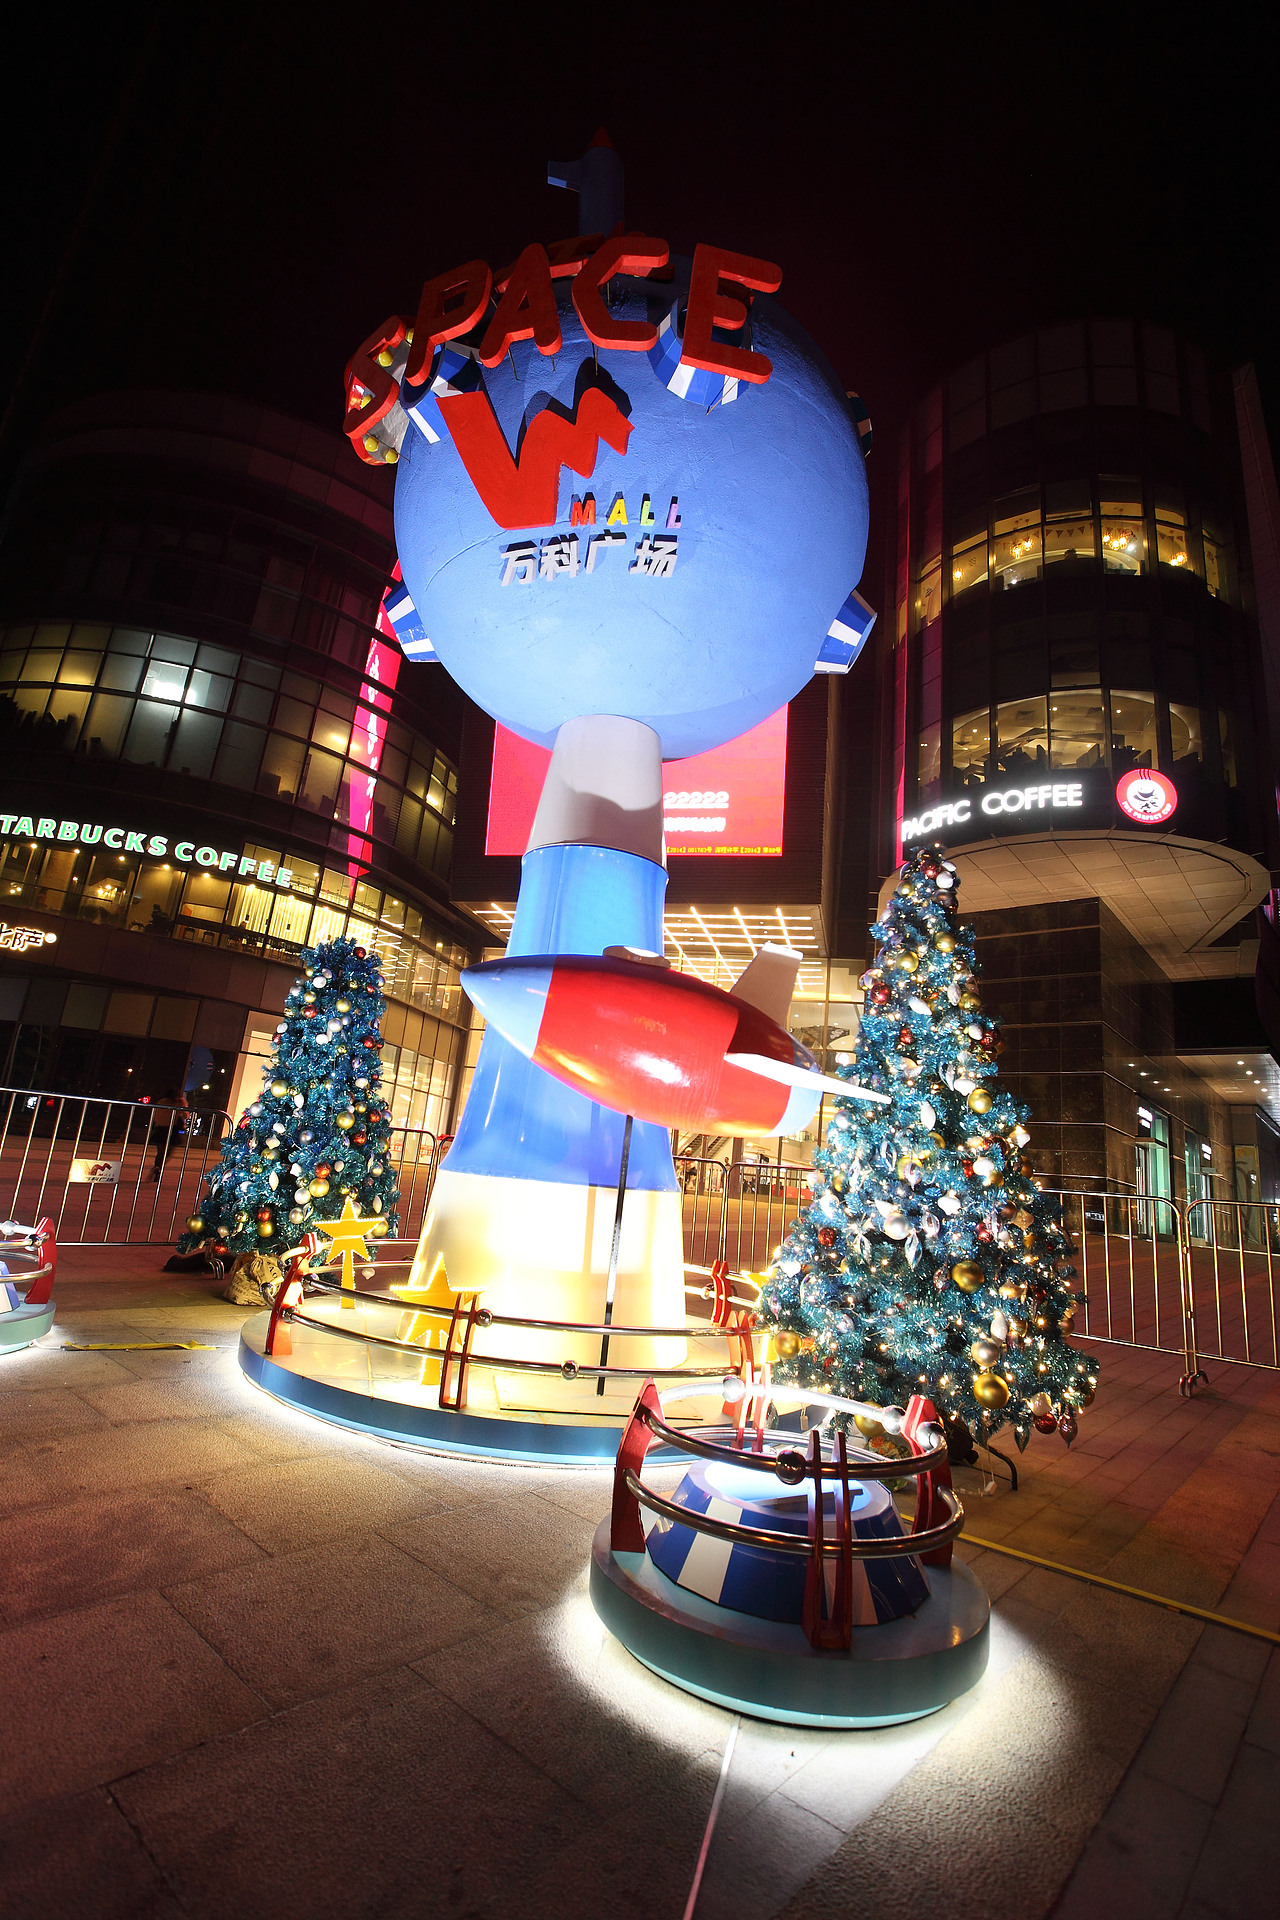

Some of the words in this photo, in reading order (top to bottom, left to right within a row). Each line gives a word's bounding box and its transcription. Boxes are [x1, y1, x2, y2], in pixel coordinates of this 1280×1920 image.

[343, 236, 782, 439] SPACE
[569, 492, 683, 528] MALL
[500, 530, 679, 587] 万科广场
[900, 800, 972, 843] PACIFIC
[980, 783, 1083, 816] COFFEE
[174, 841, 294, 888] COFFEE
